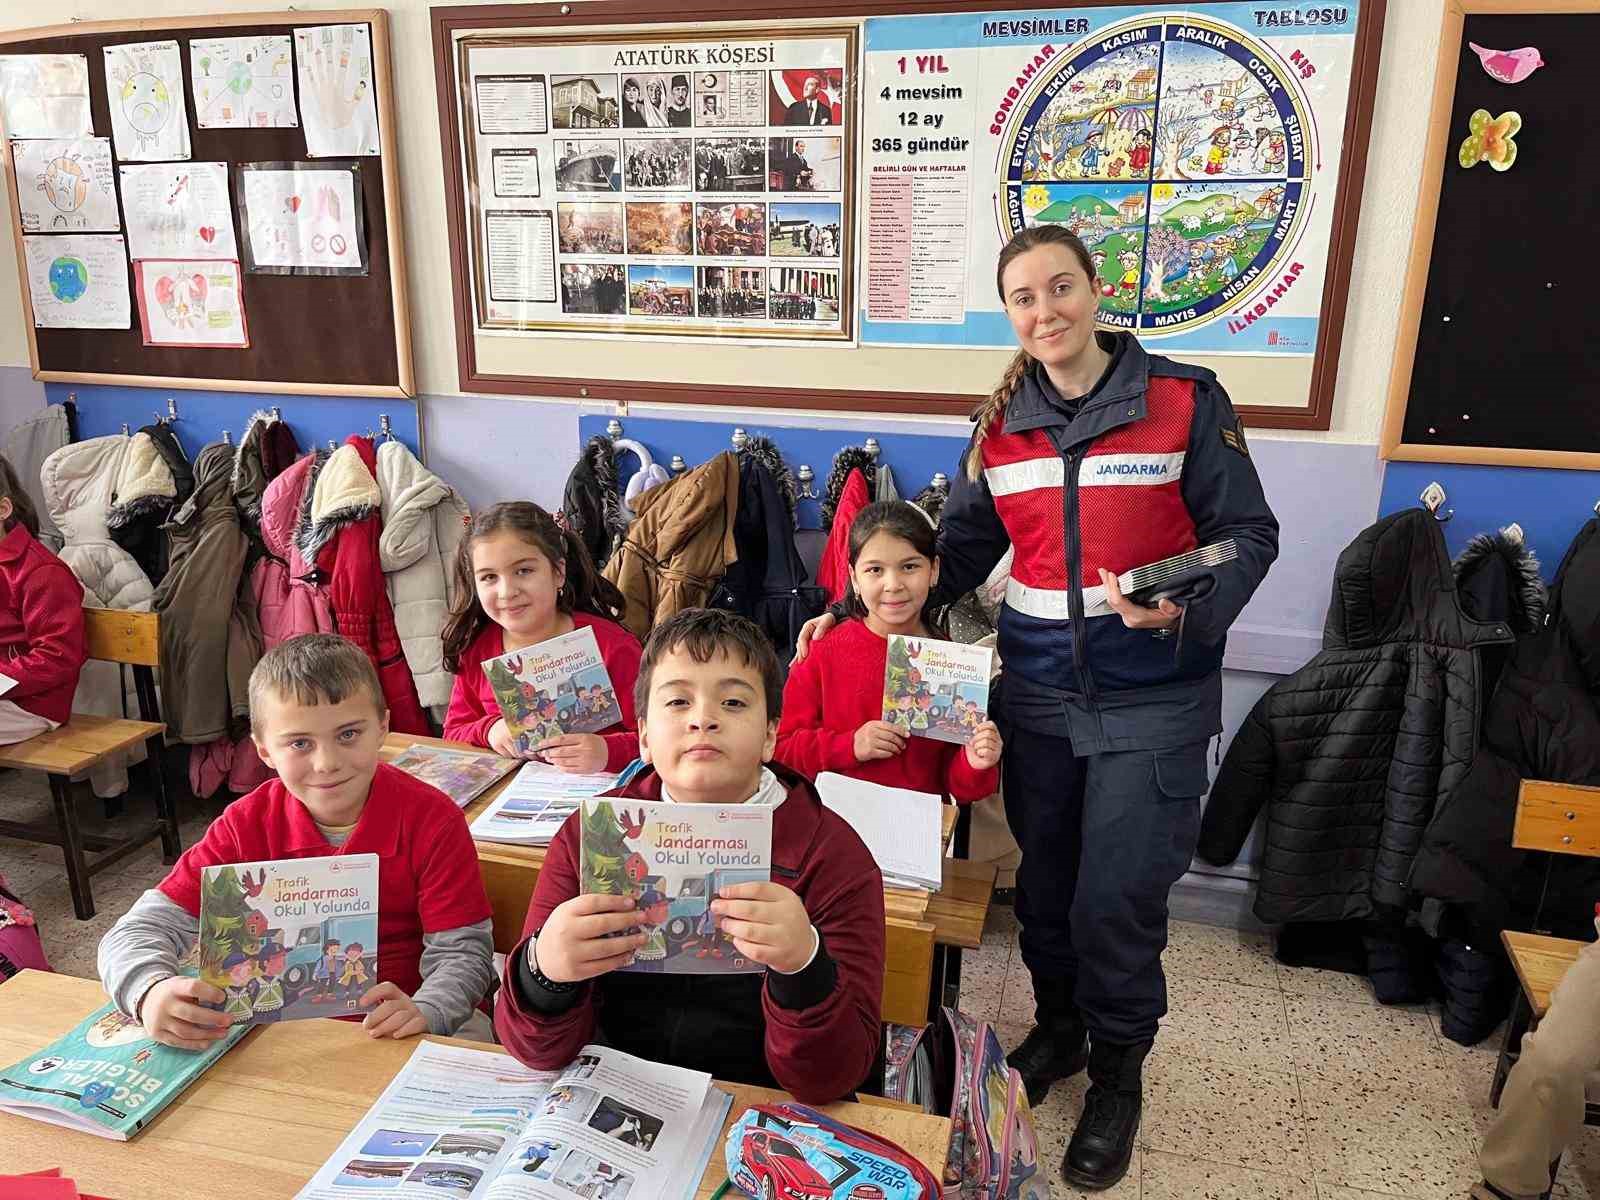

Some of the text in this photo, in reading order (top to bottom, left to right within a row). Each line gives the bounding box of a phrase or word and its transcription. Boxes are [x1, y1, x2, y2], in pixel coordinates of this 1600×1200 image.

[983, 16, 1089, 37] MEVSİMLER
[1254, 8, 1349, 26] TABLOSU
[1101, 28, 1149, 53] KASIM
[1175, 26, 1229, 50] ARALIK
[613, 42, 776, 67] ATATÜRK KÖŞESİ
[897, 55, 949, 74] 1 YIL
[1289, 48, 1317, 80] KIŞ
[1044, 64, 1077, 97] EKİM
[1248, 58, 1282, 93] OCAK
[880, 84, 962, 101] 4 mevsim
[989, 44, 1056, 136] SONBAHAR
[898, 111, 944, 128] 12 ay
[872, 136, 970, 155] 365 gündür
[1010, 124, 1035, 168] EYLÜL
[1284, 114, 1304, 162] ŞUBAT
[873, 165, 900, 173] BELİRLİ
[1008, 189, 1024, 234] AĞUST
[1273, 199, 1298, 242] MART
[1221, 264, 1262, 302] NİSAN
[1154, 308, 1197, 327] MAYIS
[1096, 463, 1169, 476] JANDARMA
[655, 822, 694, 833] Trafik
[654, 835, 749, 849] Jandarması
[654, 850, 761, 865] Okul Yolunda
[274, 876, 310, 888] Trafik
[273, 887, 359, 904] Jandarması
[273, 898, 371, 918] Okul Yolunda
[60, 1058, 164, 1094] BİLGİLER
[847, 1151, 909, 1180] SPEED
[867, 1169, 906, 1190] WAR
